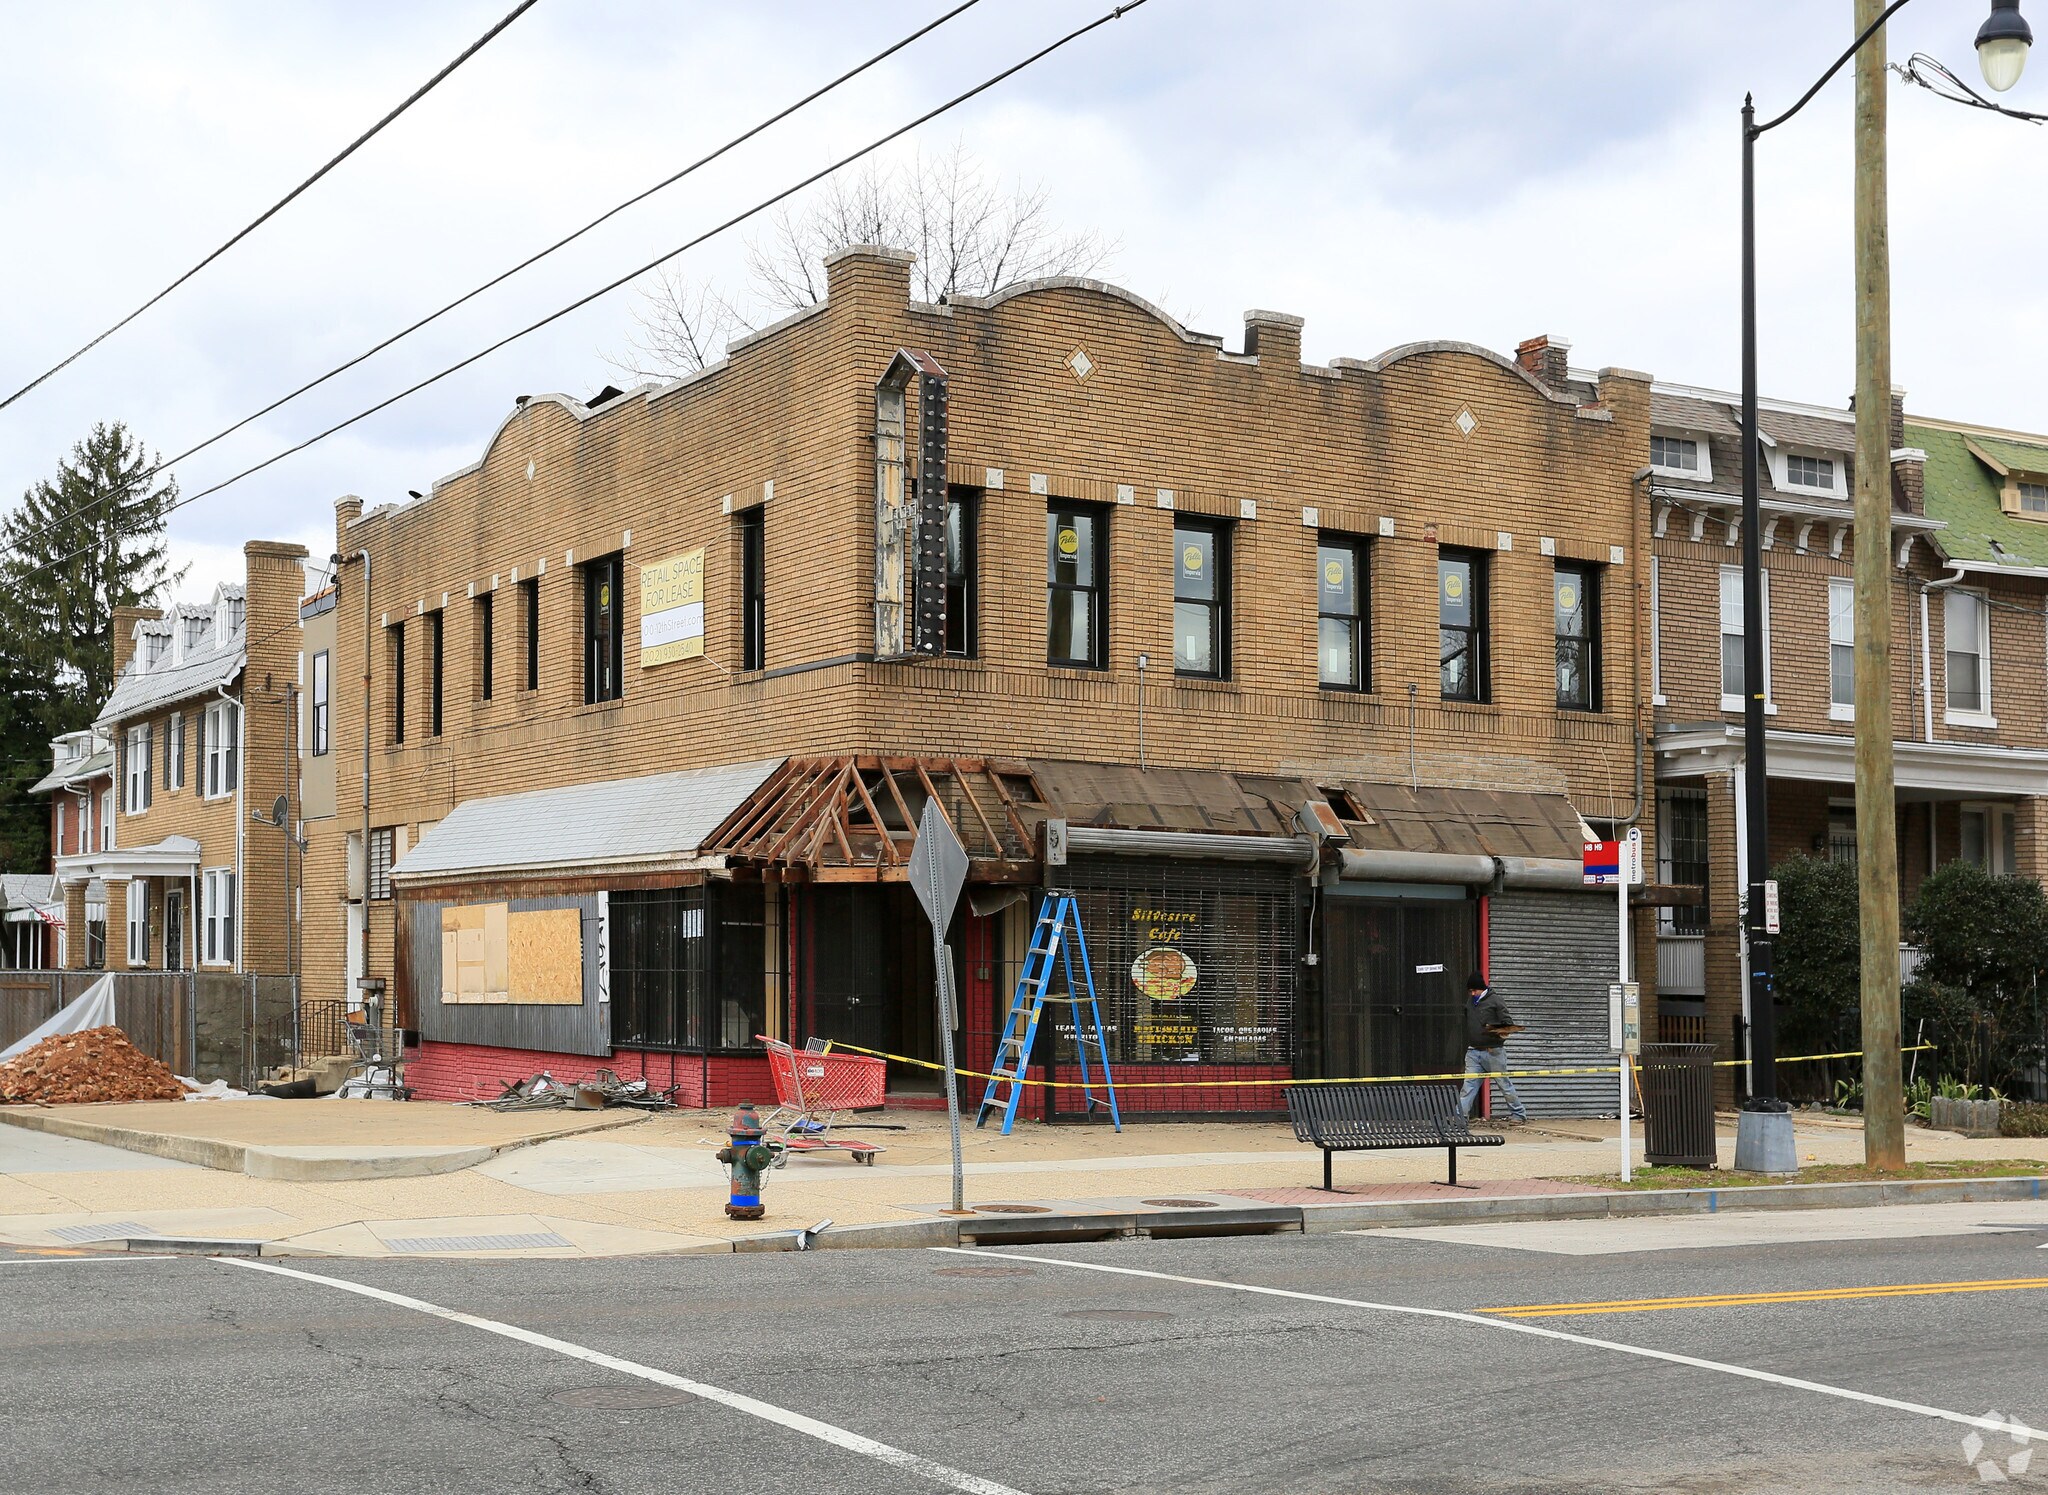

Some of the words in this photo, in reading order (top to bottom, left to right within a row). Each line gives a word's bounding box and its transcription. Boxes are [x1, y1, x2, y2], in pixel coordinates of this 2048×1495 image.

[641, 567, 671, 589] RETAIL
[672, 555, 703, 580] SPACE
[645, 588, 666, 609] FOR
[666, 579, 694, 604] LEASE
[642, 649, 662, 665] (202)
[1584, 843, 1593, 852] H8
[1594, 843, 1603, 851] H9
[1131, 908, 1197, 923] Silvestre
[1148, 927, 1182, 943] Cafe
[1137, 1034, 1194, 1045] CHICKEN
